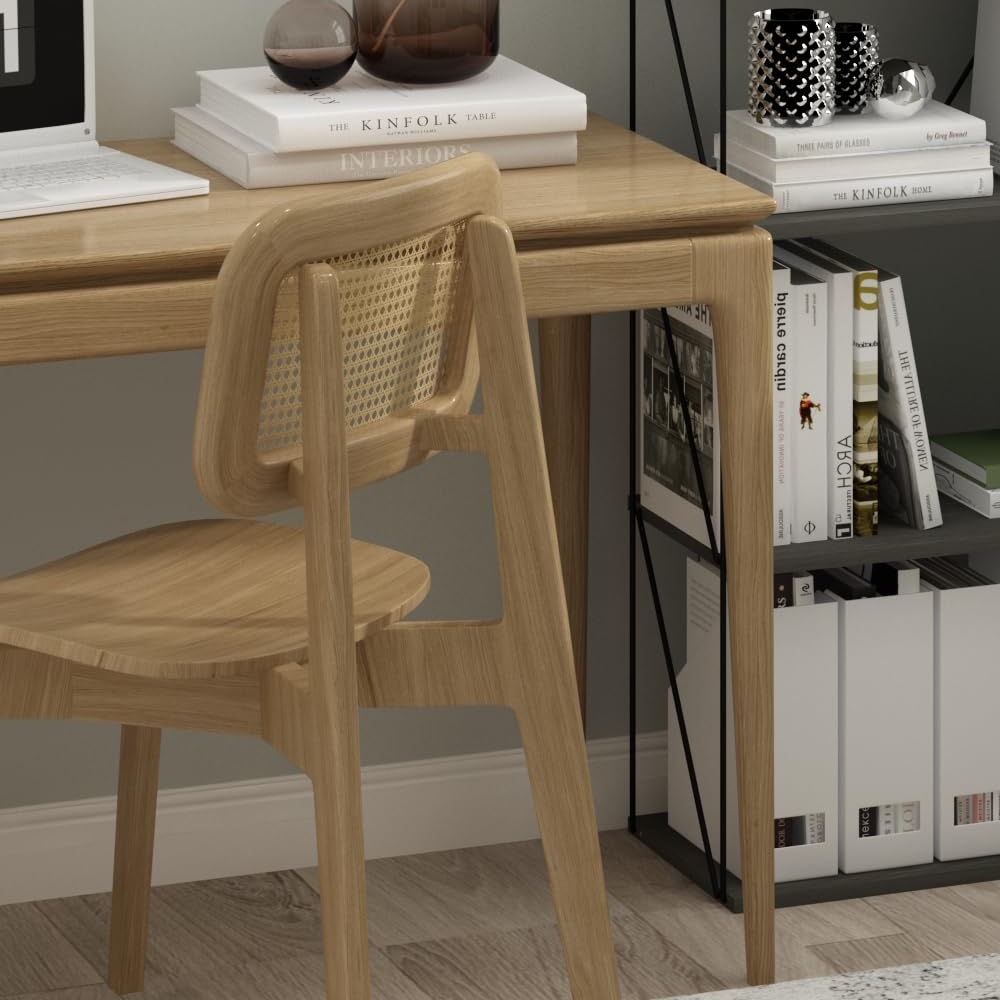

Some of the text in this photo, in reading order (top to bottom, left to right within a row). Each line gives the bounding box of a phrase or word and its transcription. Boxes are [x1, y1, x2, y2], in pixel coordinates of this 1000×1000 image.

[328, 112, 496, 132] THE KINFOLK TABLE
[797, 142, 815, 152] THREE
[816, 141, 834, 150] PAIRS
[835, 140, 842, 149] OF
[833, 185, 932, 201] THE KINFOLK HOME
